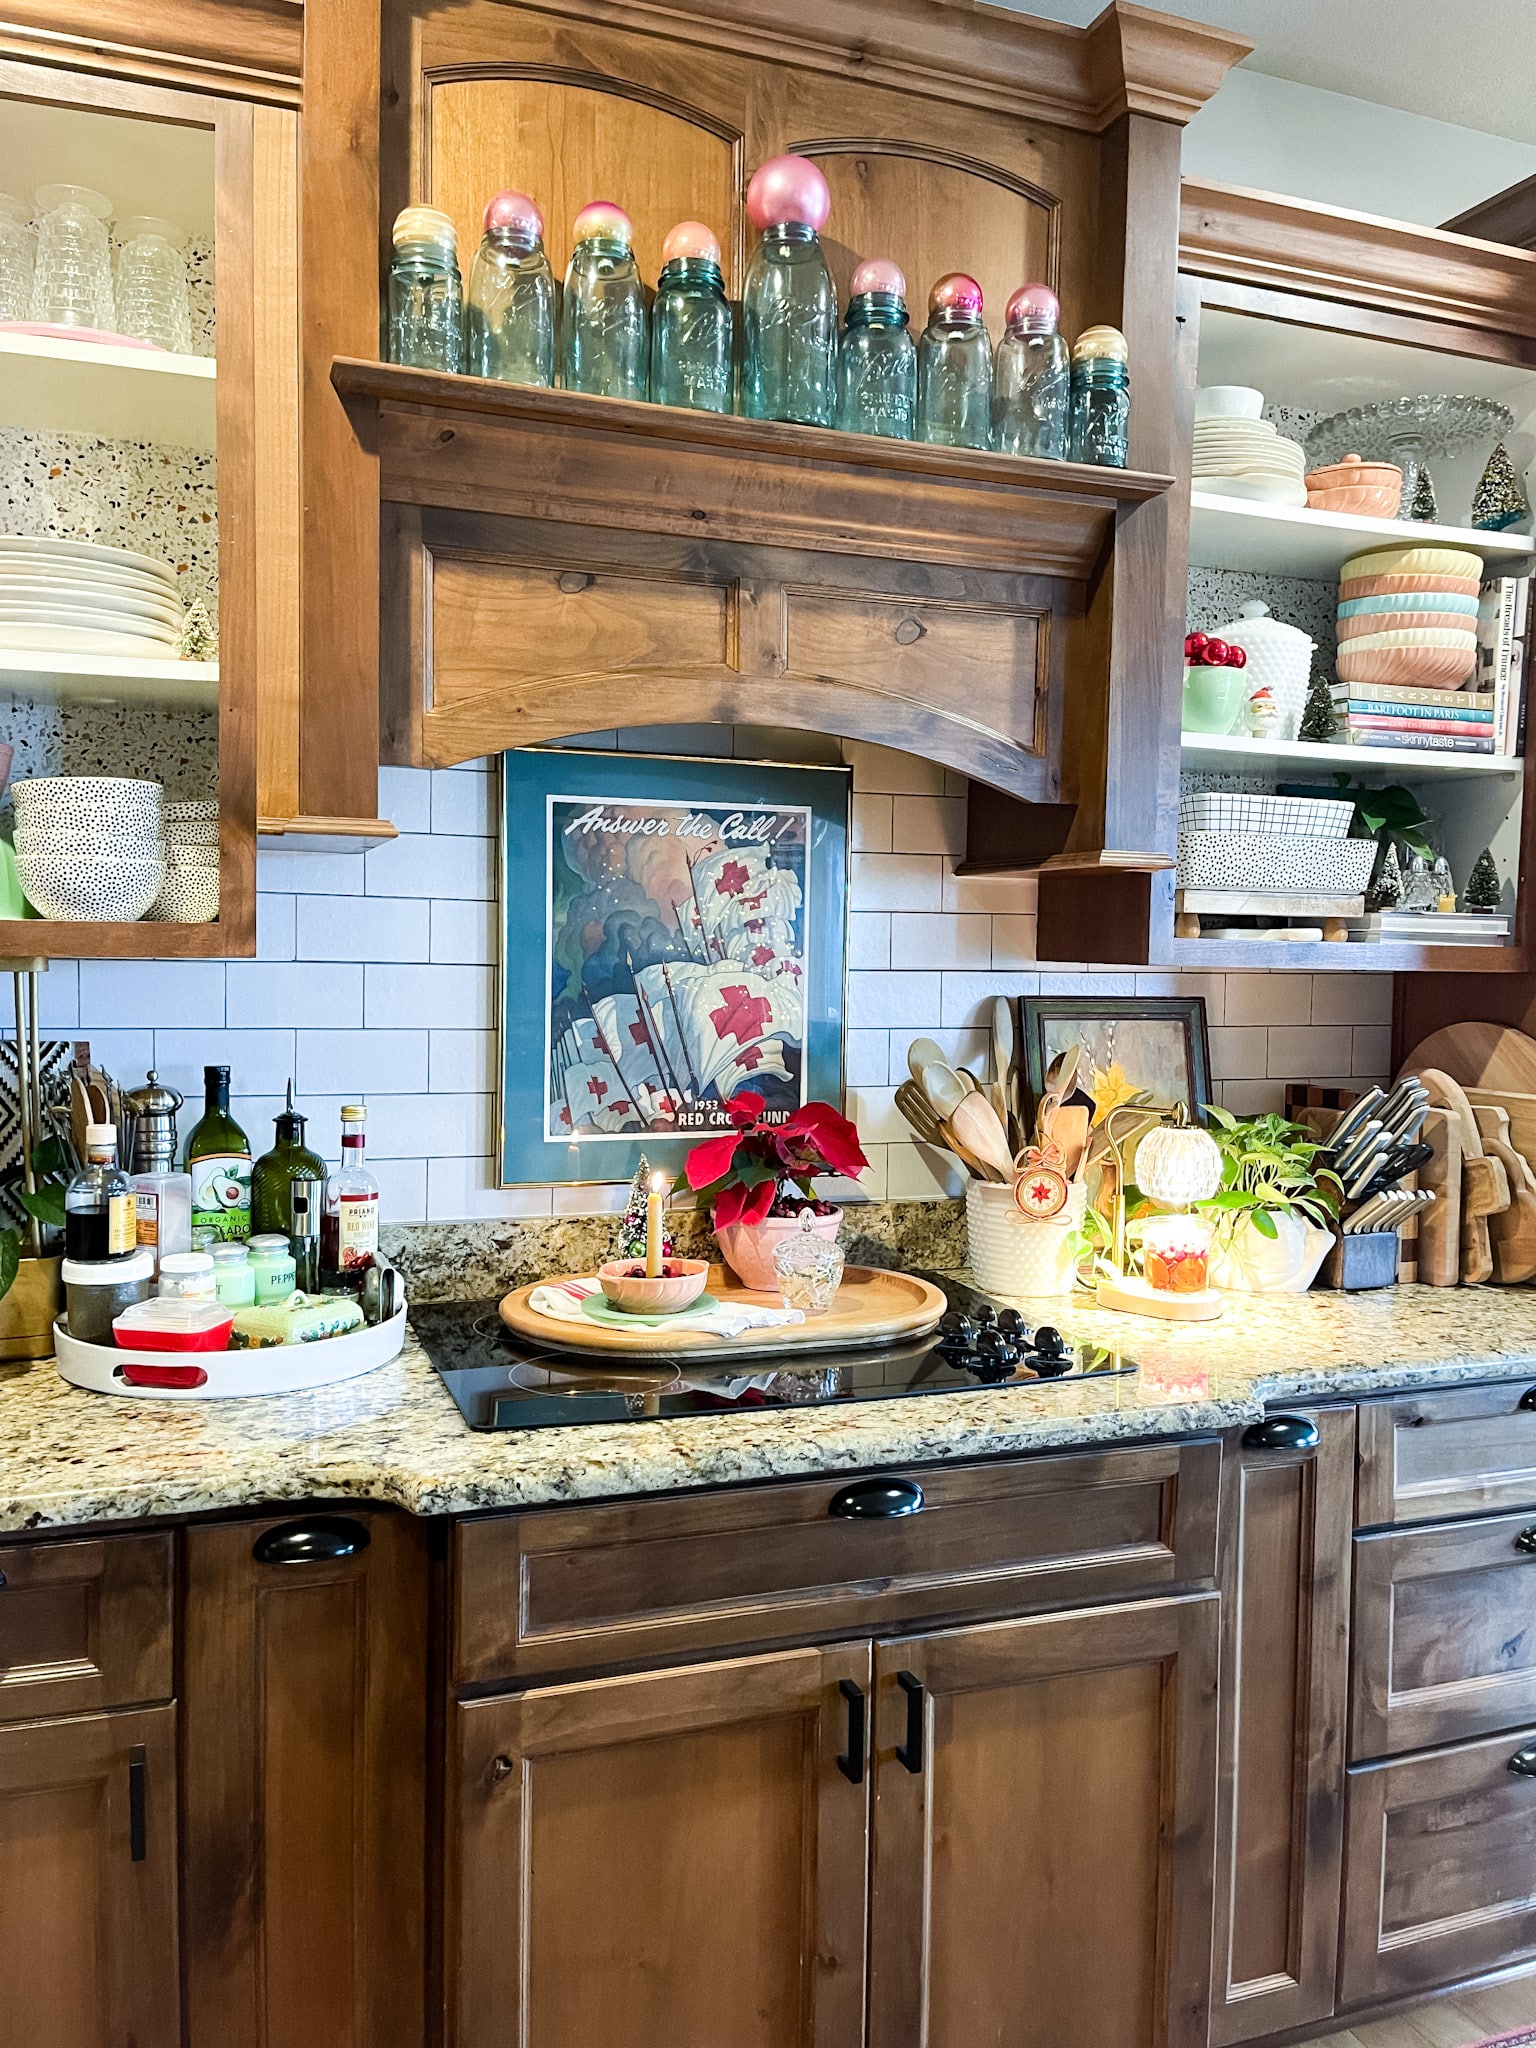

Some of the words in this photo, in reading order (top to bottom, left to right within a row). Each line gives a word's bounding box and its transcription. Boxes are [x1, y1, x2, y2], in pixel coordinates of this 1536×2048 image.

[1505, 584, 1514, 602] The
[1502, 604, 1513, 636] Breads
[1502, 637, 1510, 646] of
[1500, 649, 1509, 681] France
[1383, 690, 1465, 704] HARVEST
[1367, 703, 1418, 716] BAREFOOT
[1420, 707, 1432, 718] IN
[1434, 708, 1460, 720] PARIS
[1401, 733, 1455, 748] skinnytaste
[564, 805, 671, 836] Answer
[673, 812, 713, 839] the
[694, 1100, 718, 1111] 1953
[678, 1112, 705, 1126] RED
[709, 1112, 732, 1125] CRO
[349, 1207, 375, 1215] PRIANO
[201, 1215, 247, 1223] ORGANIC
